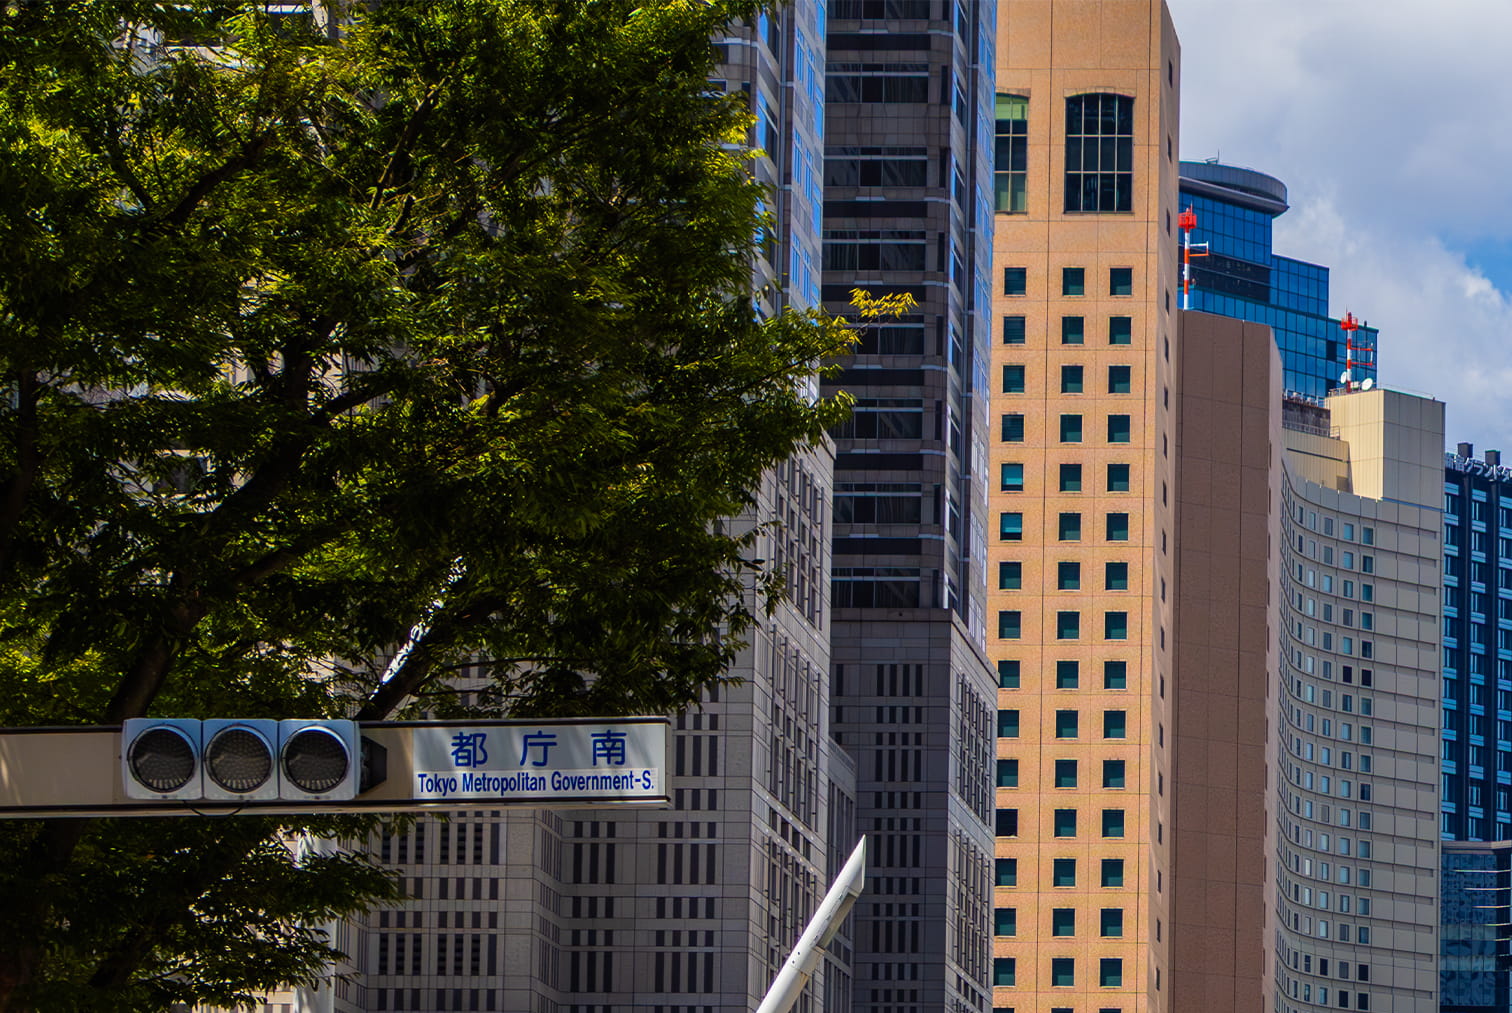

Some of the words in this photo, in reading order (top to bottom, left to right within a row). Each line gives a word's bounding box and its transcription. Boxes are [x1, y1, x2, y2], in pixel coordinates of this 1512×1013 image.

[451, 729, 627, 768] 都庁南
[418, 773, 457, 797] Tokyo
[462, 772, 546, 796] Metropolitan
[551, 770, 655, 791] Government-S.
